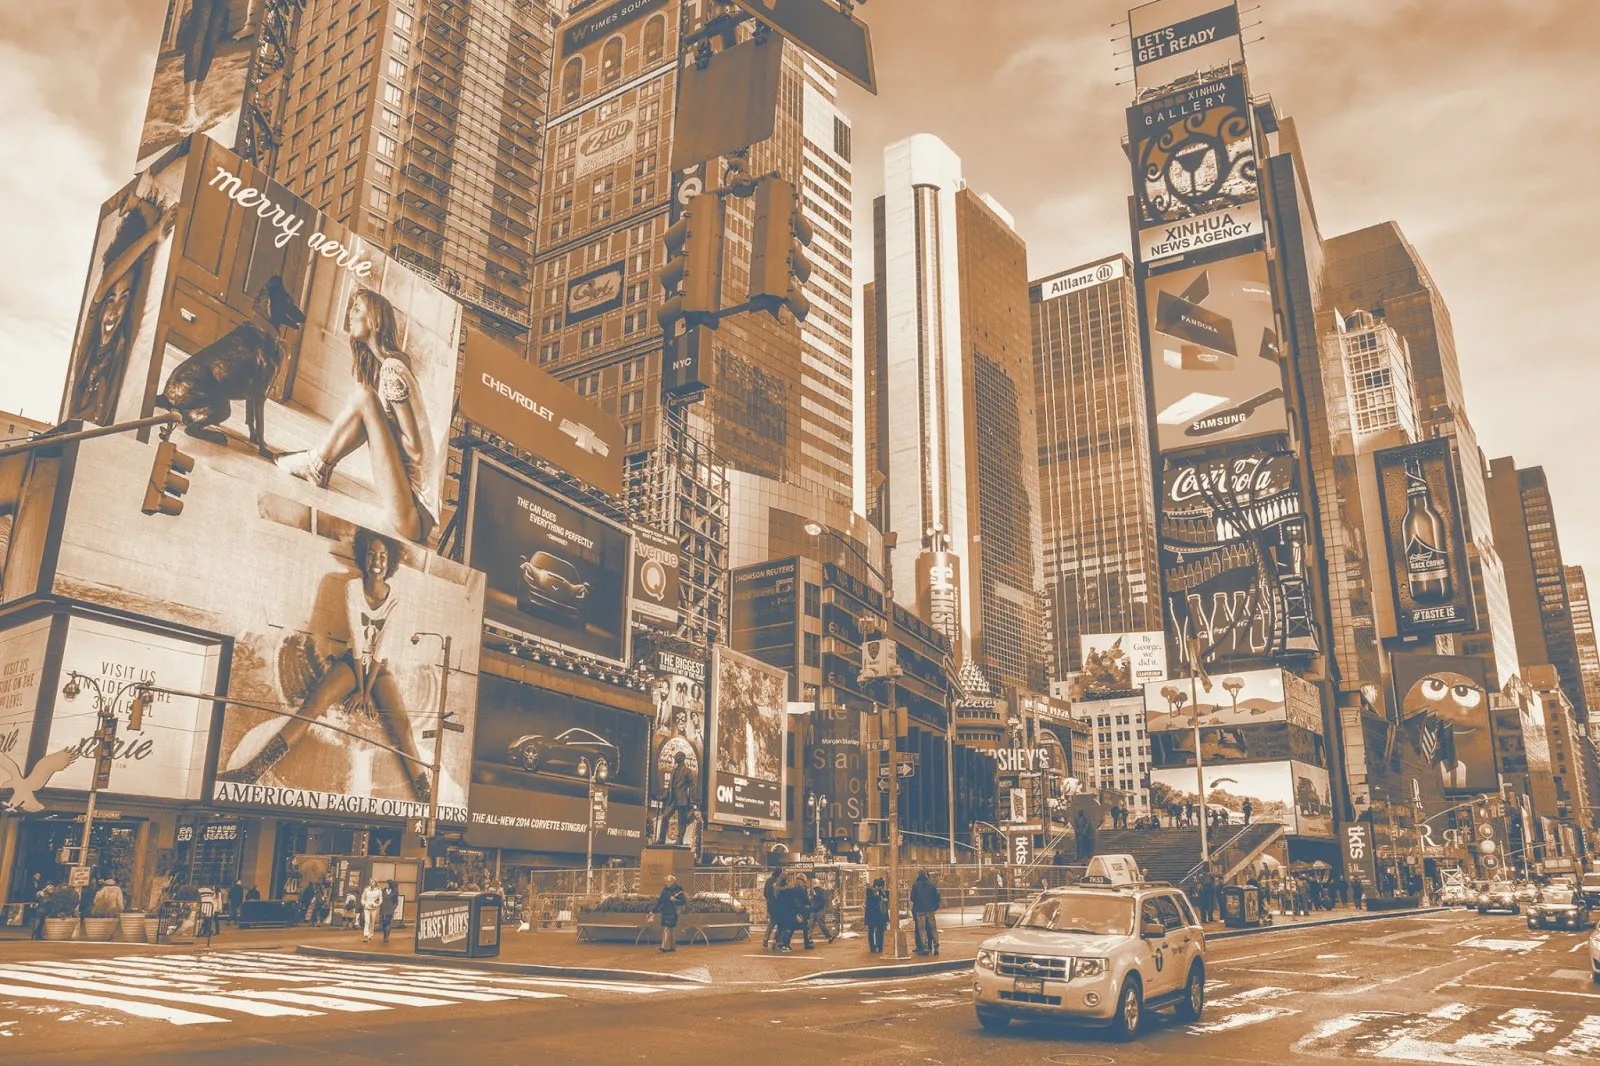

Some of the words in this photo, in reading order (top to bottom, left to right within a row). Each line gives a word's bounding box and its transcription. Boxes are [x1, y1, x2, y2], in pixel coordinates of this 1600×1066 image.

[590, 12, 618, 32] TIMES
[1137, 28, 1175, 49] LET'S
[1138, 44, 1165, 62] GET
[1170, 27, 1215, 53] READY
[1188, 82, 1226, 100] XINHUA
[1145, 93, 1226, 126] GALLERY
[585, 119, 629, 156] Z100
[208, 166, 305, 249] merry
[307, 232, 373, 277] aerie
[1165, 213, 1235, 242] XINHUA
[1151, 239, 1190, 256] NEWS
[1193, 222, 1252, 246] AGENCY
[1051, 273, 1094, 294] Allianz
[1181, 315, 1219, 334] PANDORA
[672, 357, 692, 370] NYC
[482, 372, 555, 422] CHEVROLET
[1193, 413, 1247, 431] SAMSUNG
[517, 496, 529, 509] THE
[529, 502, 542, 515] CAR
[541, 508, 557, 523] DOES
[529, 512, 564, 536] EVERYTHING
[564, 529, 594, 550] PERFECTLY
[634, 537, 679, 568] Avenue
[641, 560, 667, 601] Q
[735, 570, 766, 583] THOMSON
[766, 564, 795, 577] REUTERS
[1446, 608, 1455, 617] IS
[4, 660, 19, 674] VISIT
[19, 658, 29, 672] US
[102, 661, 135, 680] VISIT
[140, 669, 156, 684] US
[658, 652, 674, 669] THE
[675, 656, 705, 674] BIGGEST
[23, 673, 35, 687] THE
[216, 782, 321, 809] AMERICAN
[327, 794, 378, 815] EAGLE
[716, 785, 734, 803] CNN
[472, 812, 486, 823] THE
[486, 814, 516, 827] ALL-NEW
[516, 818, 530, 828] 2014
[531, 818, 560, 831] CORVETTE
[561, 821, 588, 833] STINGRAY
[1015, 836, 1029, 865] tkts
[1347, 825, 1366, 860] tkts
[417, 912, 448, 940] JERSEY
[447, 909, 469, 936] BOYS
